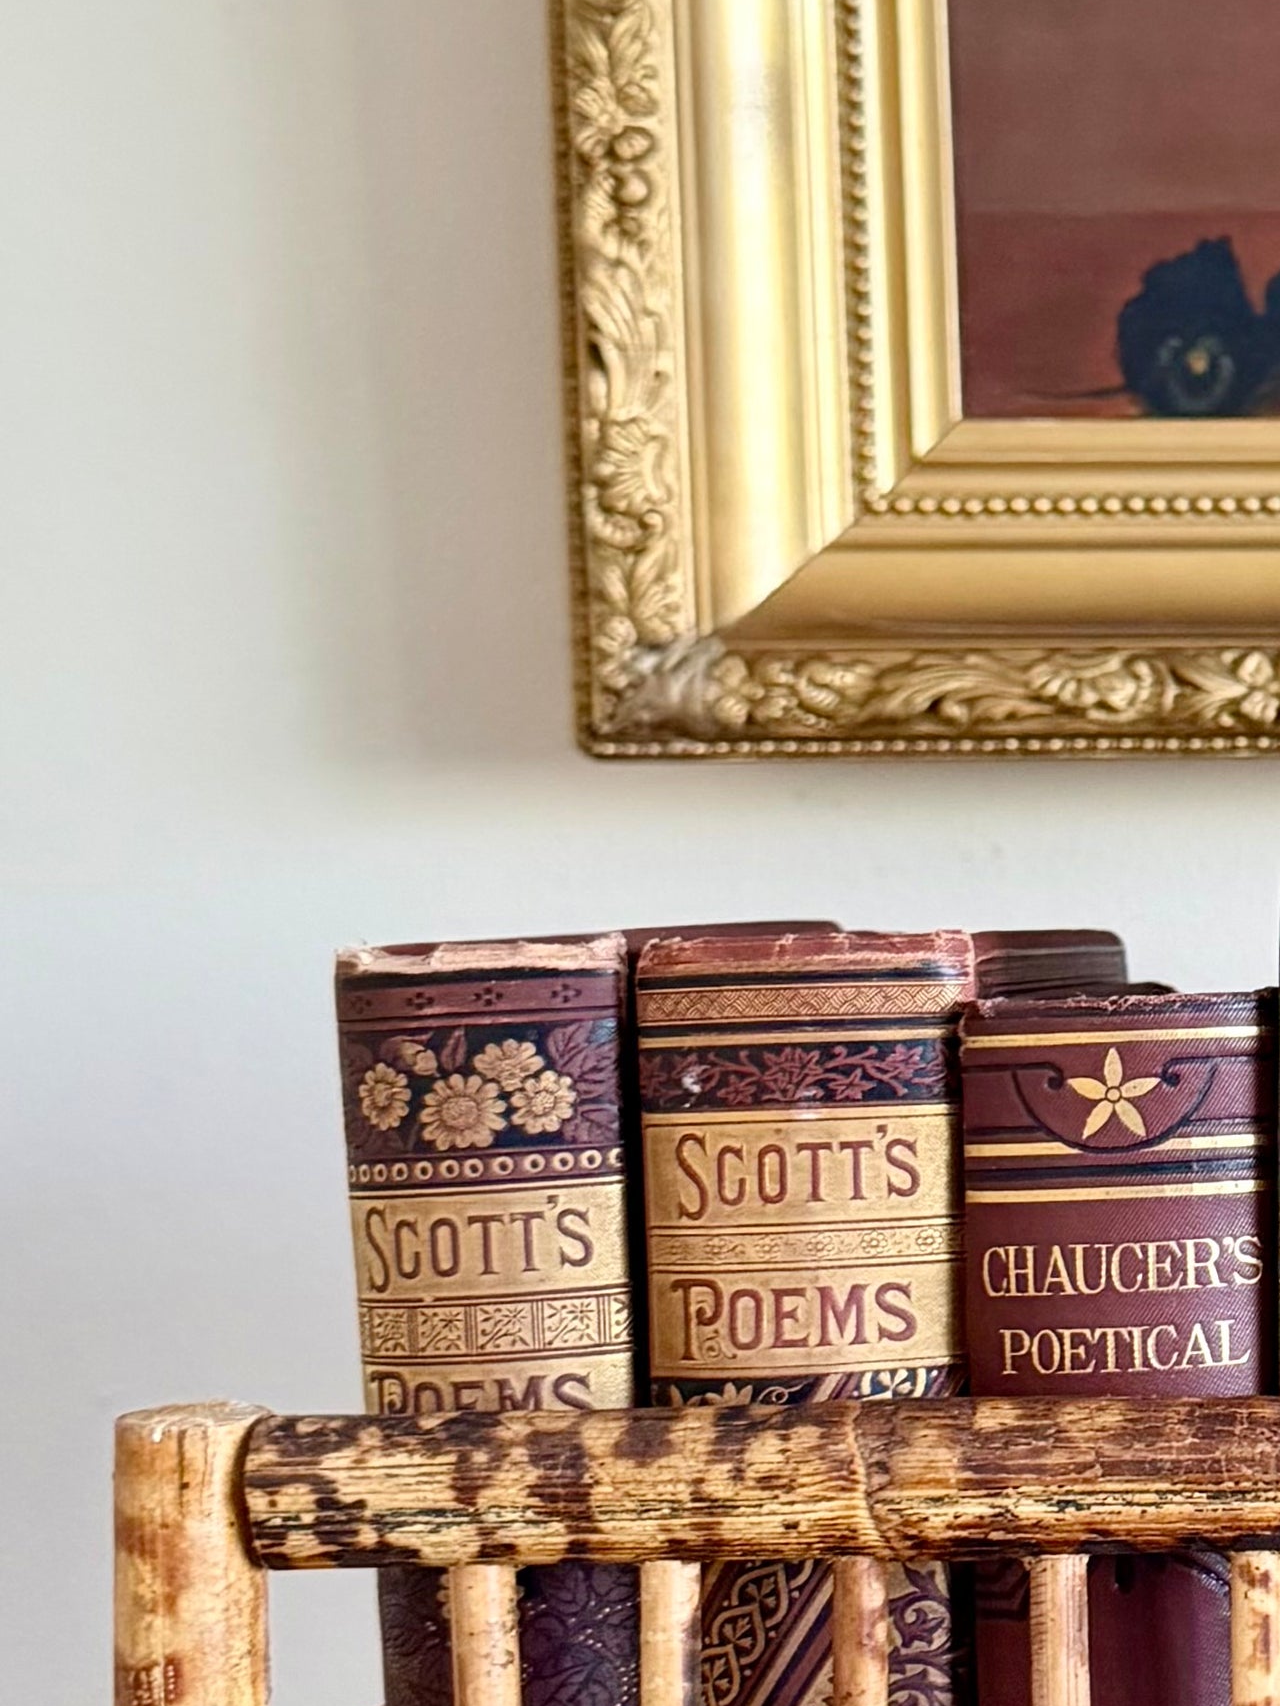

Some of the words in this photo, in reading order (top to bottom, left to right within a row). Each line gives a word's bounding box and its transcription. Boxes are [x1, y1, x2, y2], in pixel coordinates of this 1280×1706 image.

[674, 1124, 921, 1222] SCOTT'S
[364, 1193, 597, 1294] SCOTT'S
[982, 1236, 1263, 1297] CHAUCER'S
[670, 1279, 919, 1362] POEMS
[999, 1320, 1252, 1375] POETICAL
